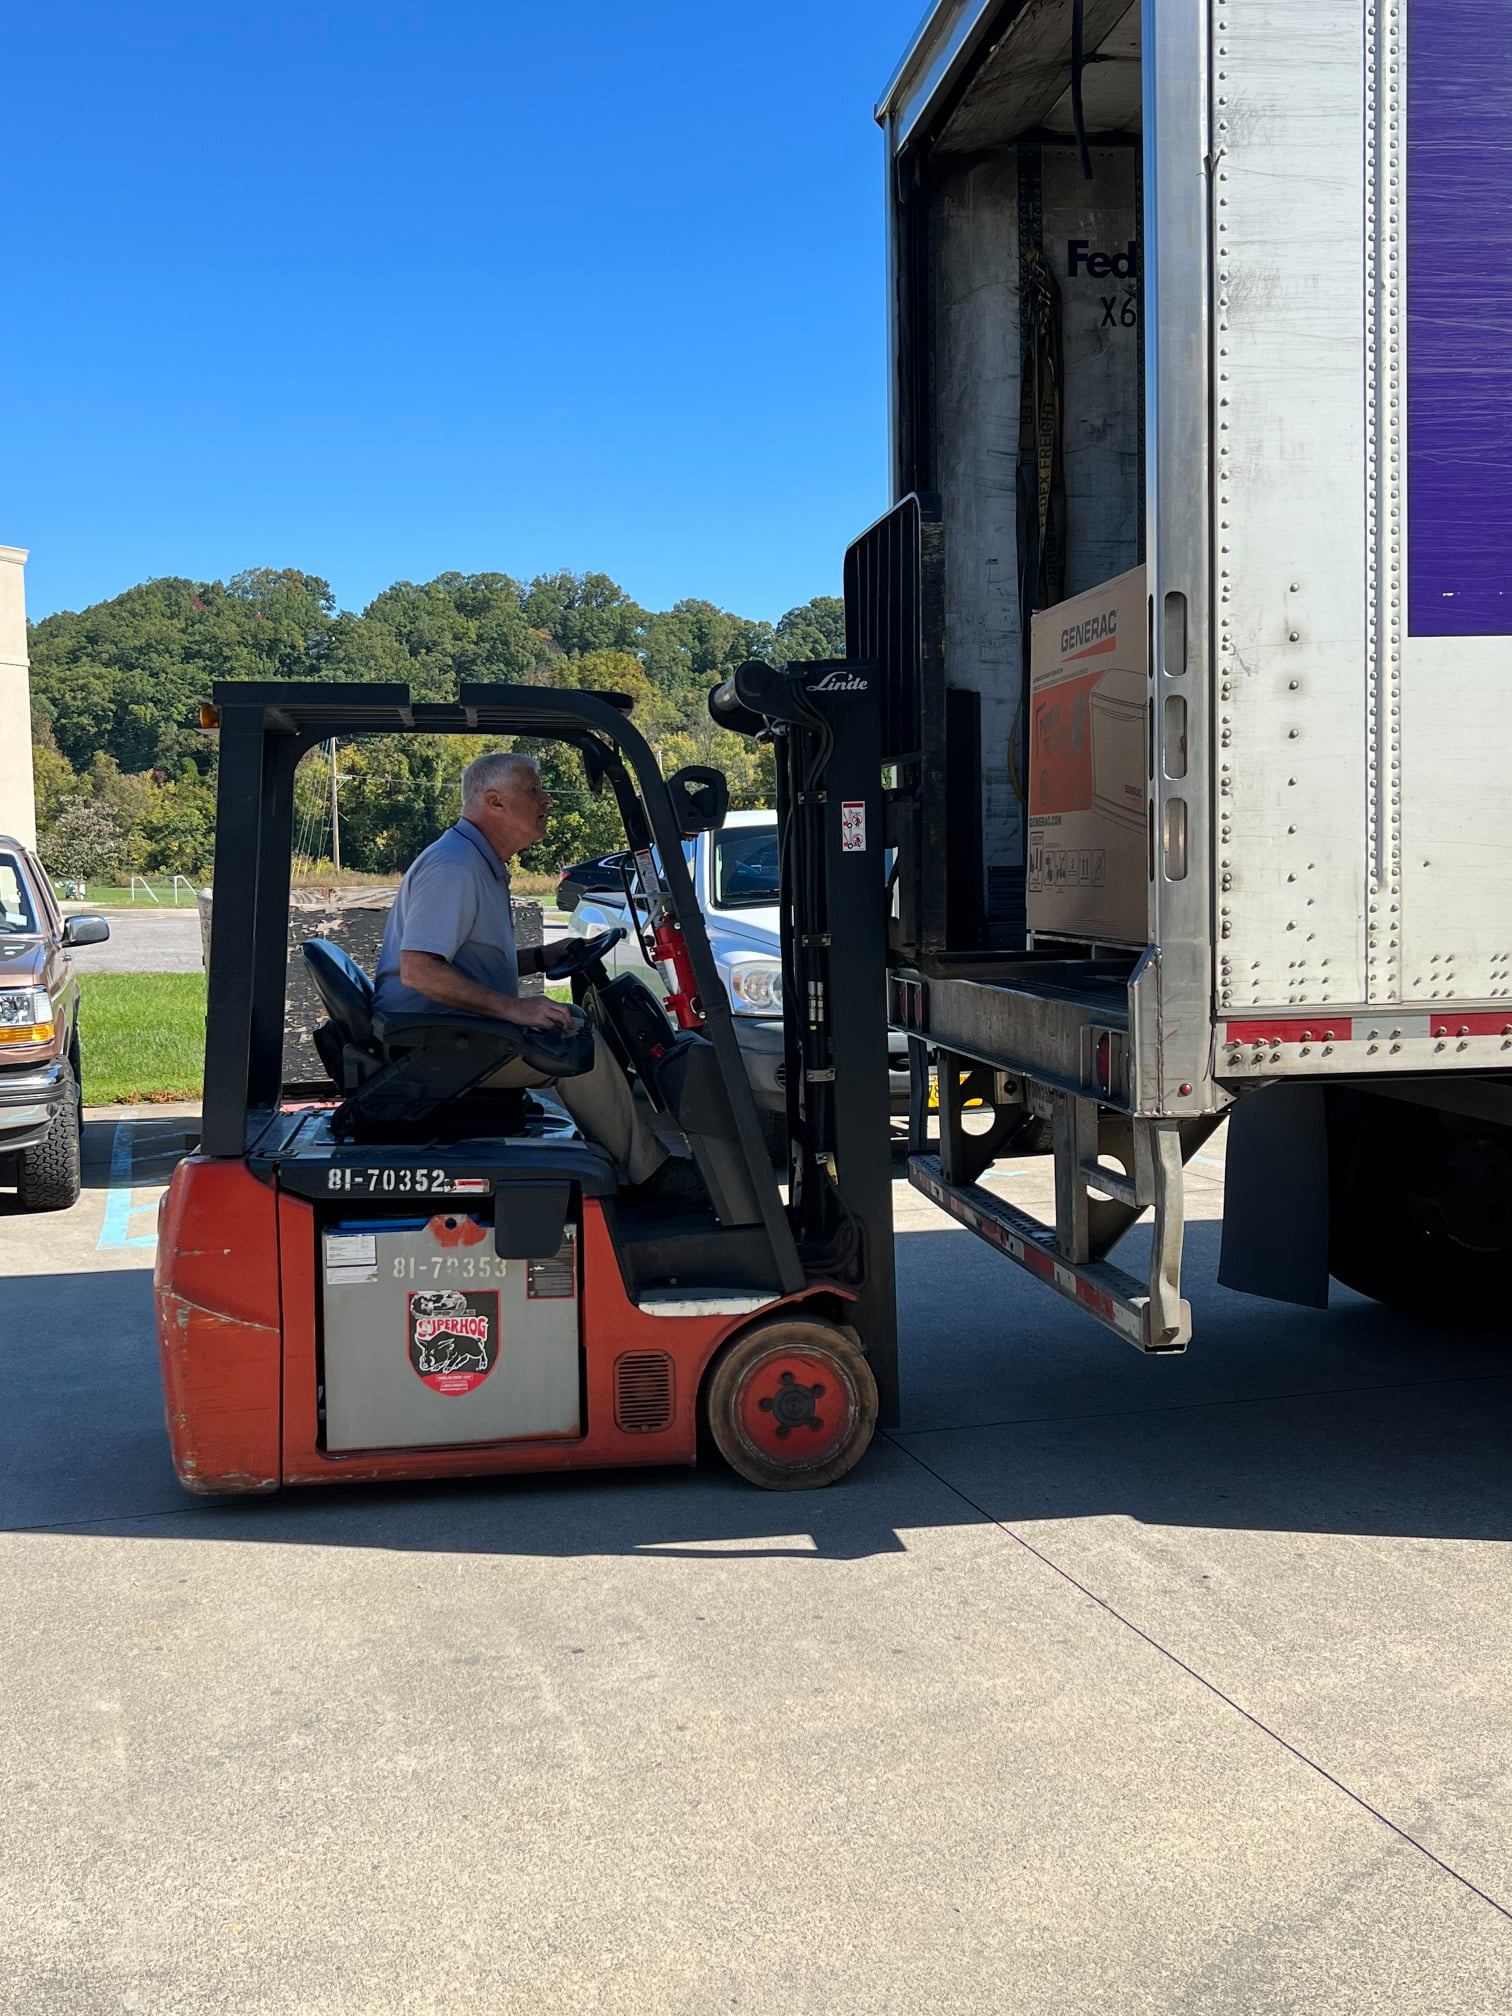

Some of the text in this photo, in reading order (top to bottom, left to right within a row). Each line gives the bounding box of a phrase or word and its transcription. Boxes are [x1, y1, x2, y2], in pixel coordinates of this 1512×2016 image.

[1100, 297, 1137, 328] X6
[1039, 400, 1056, 469] FREIGHT
[1061, 610, 1118, 652] GENERAC
[806, 671, 868, 692] Linde
[327, 1168, 446, 1192] 81-70352
